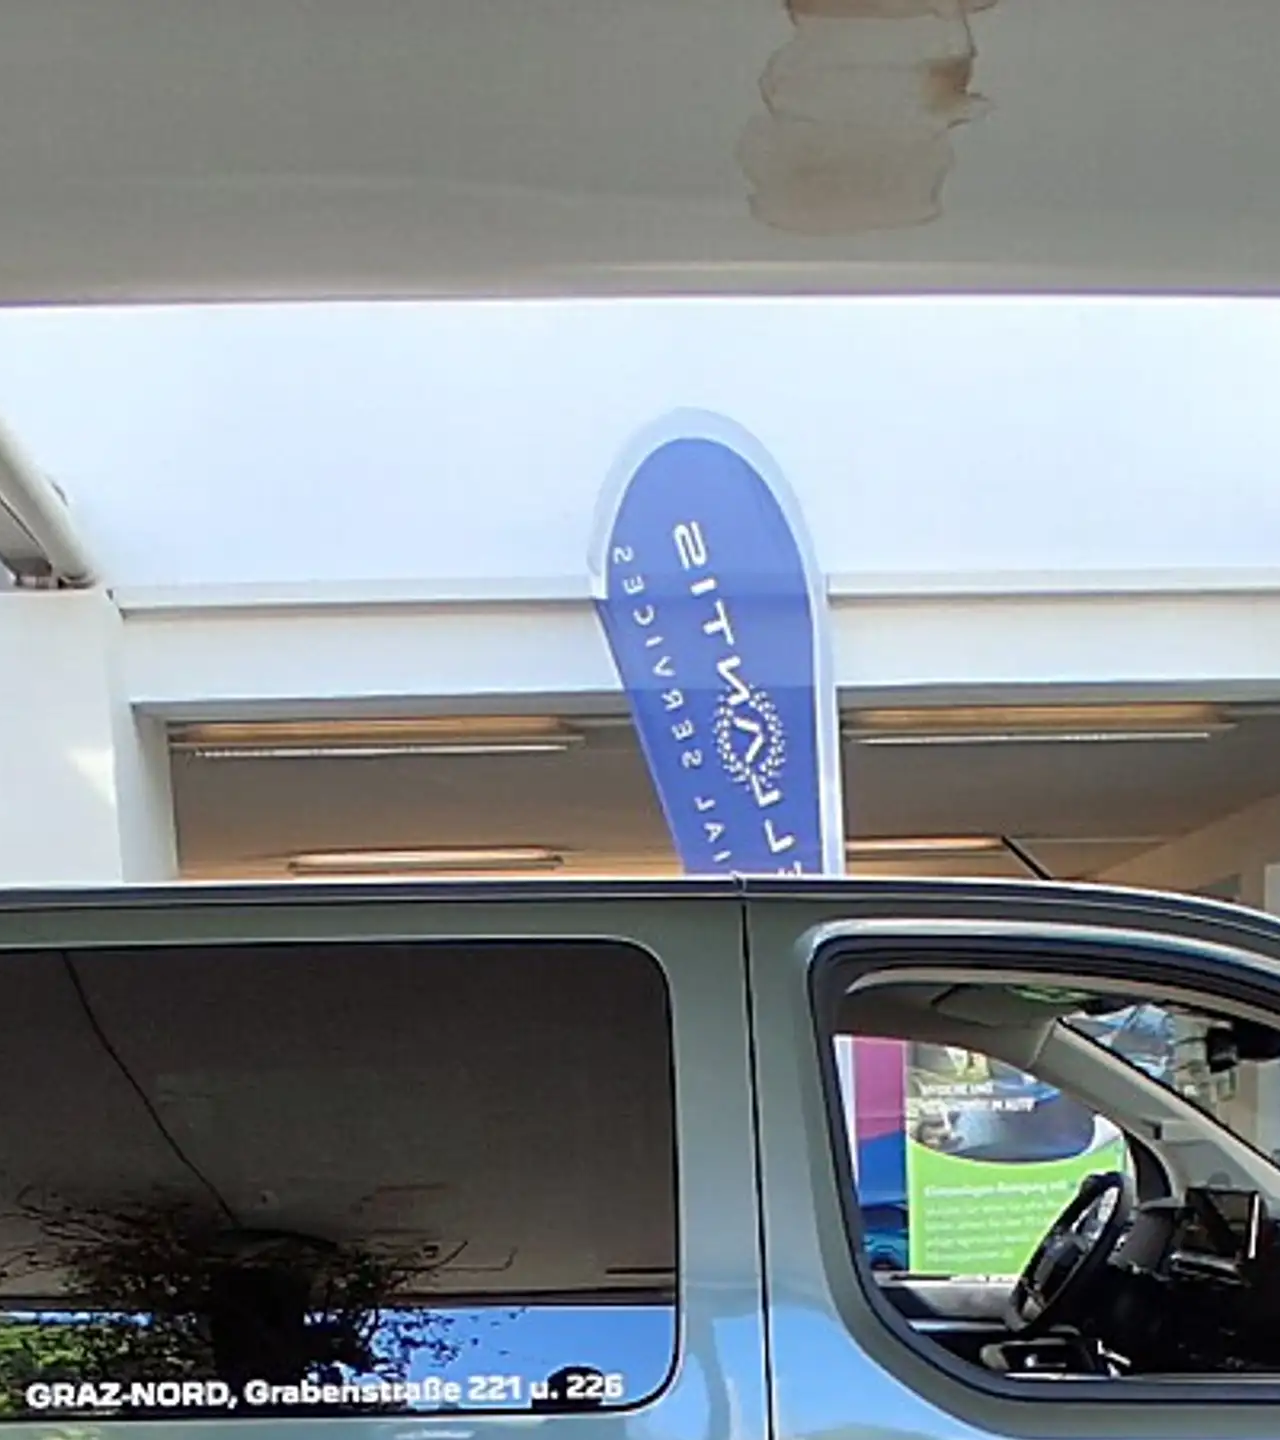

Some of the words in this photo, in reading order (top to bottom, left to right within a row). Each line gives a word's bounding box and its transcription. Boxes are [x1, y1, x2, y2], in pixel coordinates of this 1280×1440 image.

[25, 1381, 238, 1409] GRAZ-NORD,
[243, 1376, 462, 1405] Grabenstraße
[467, 1374, 522, 1400] 221
[529, 1381, 559, 1400] u.
[565, 1372, 625, 1398] 226
